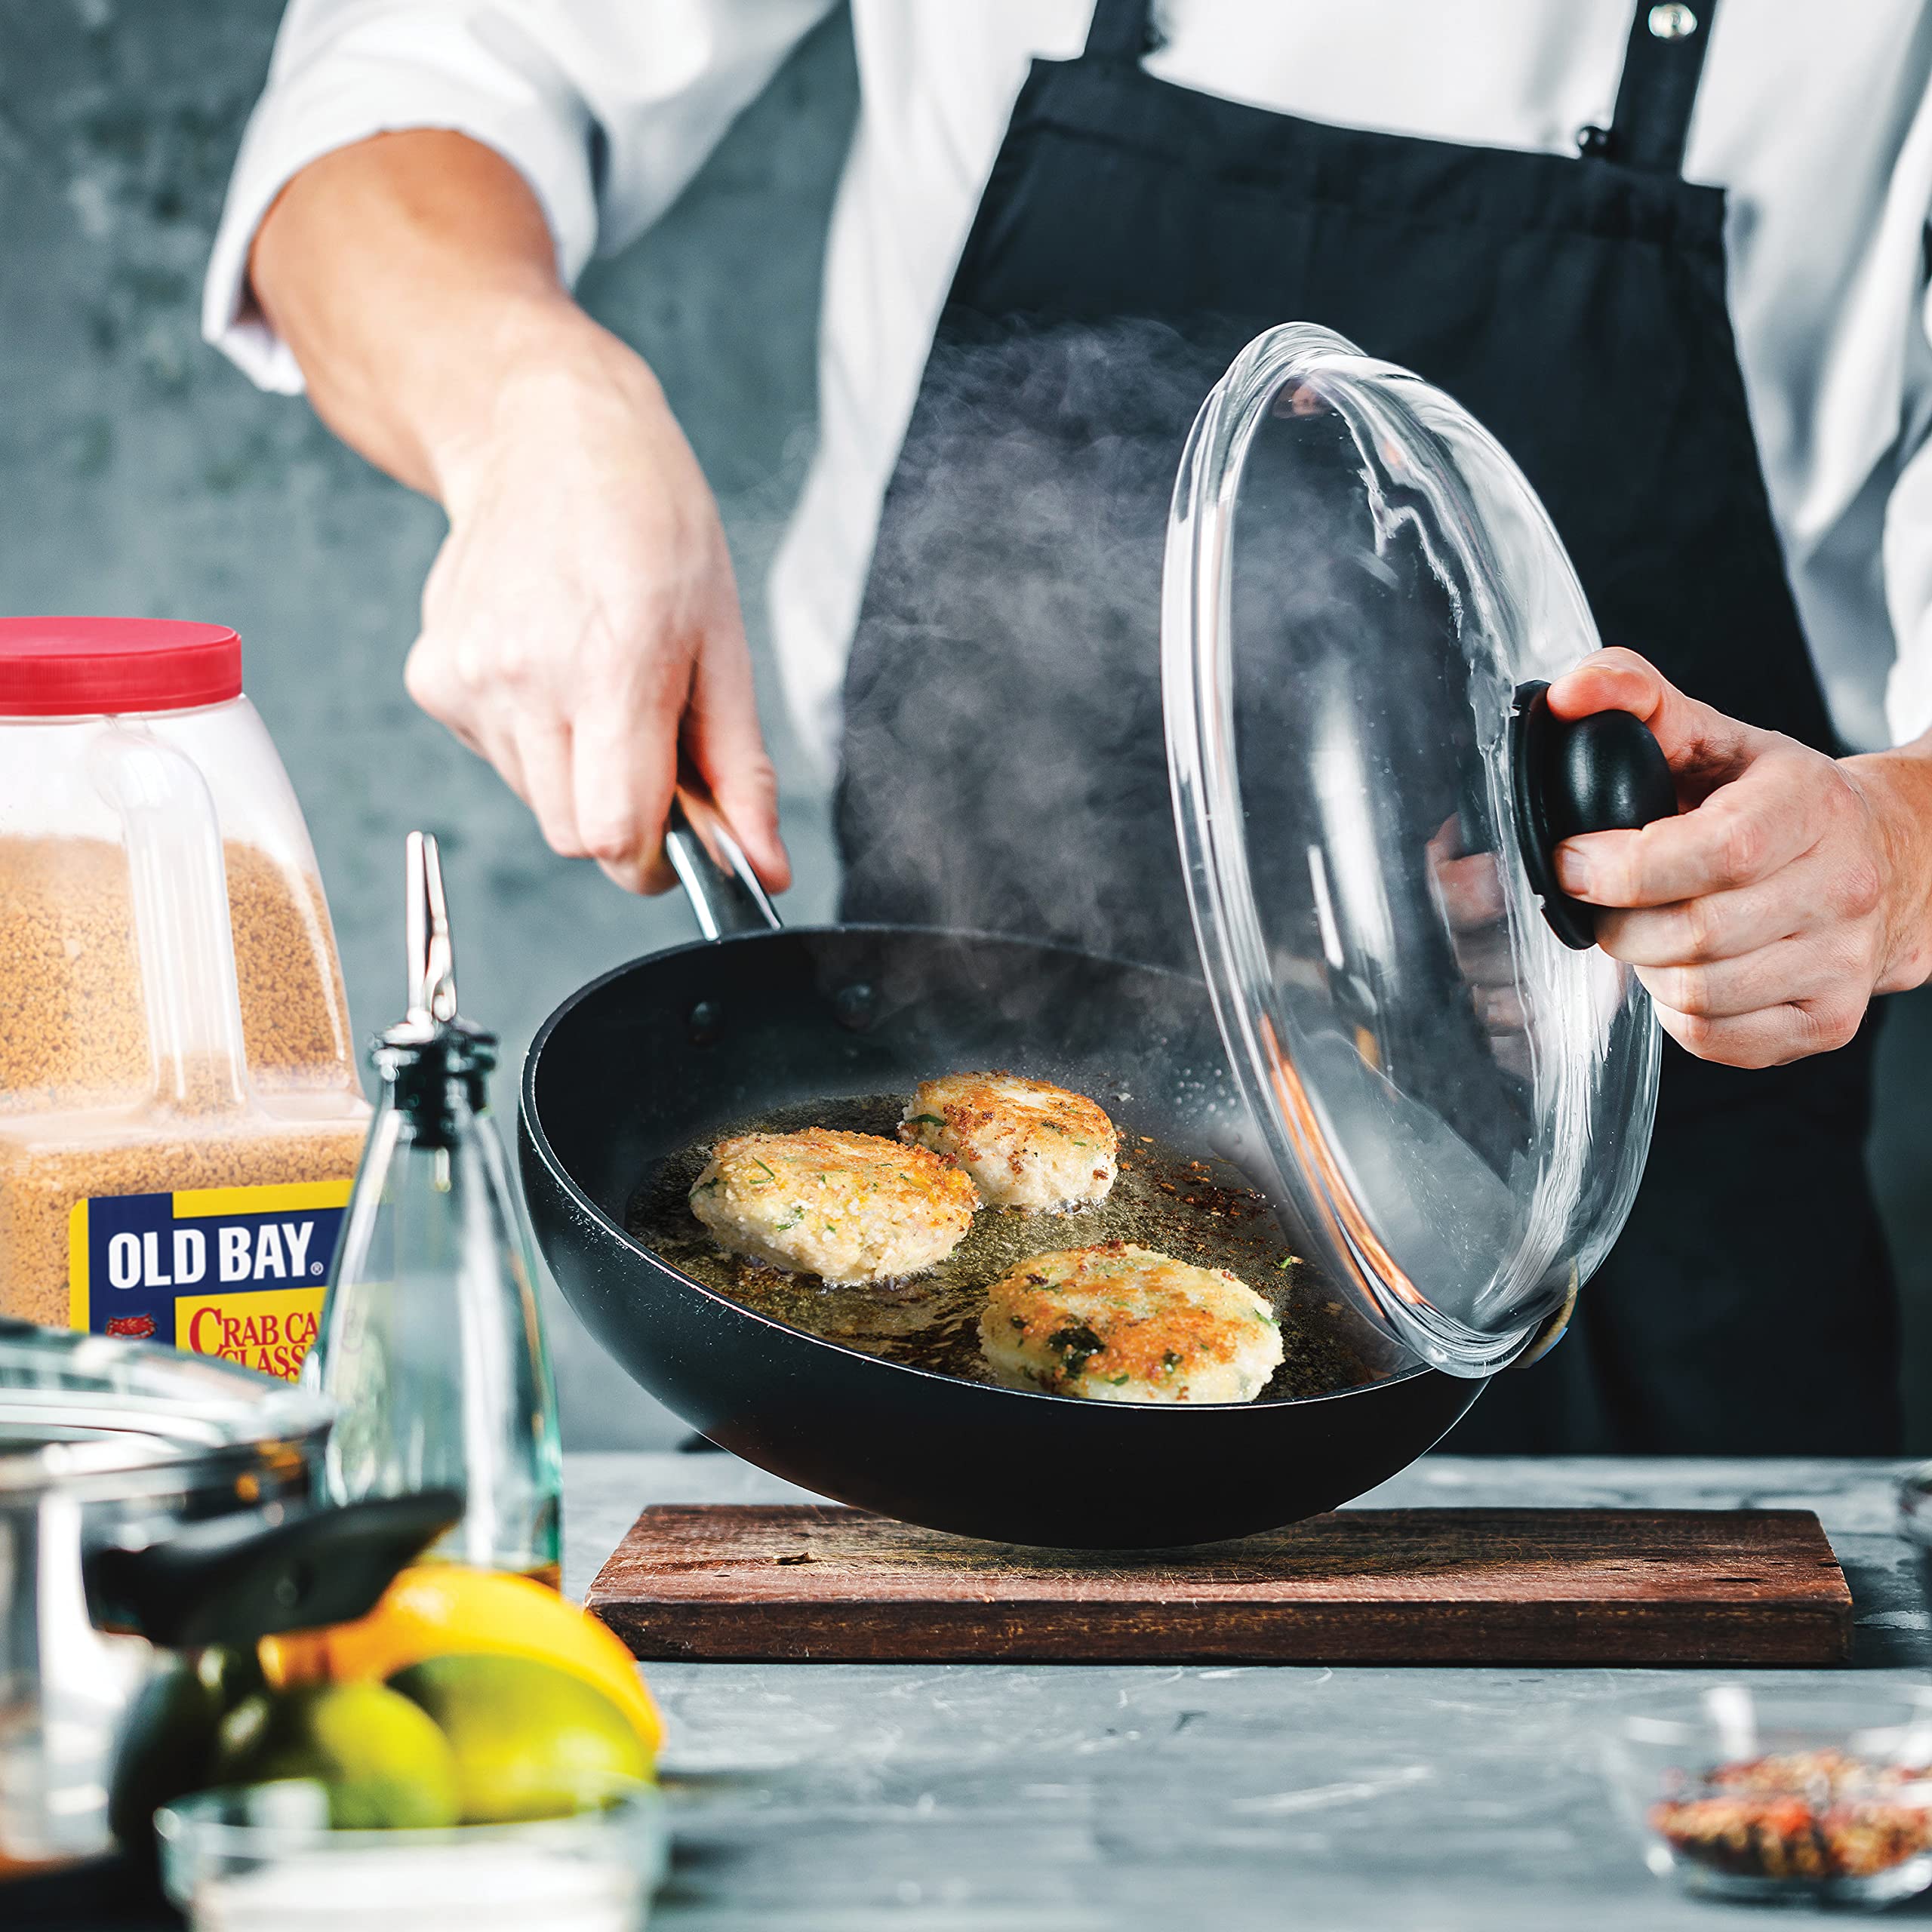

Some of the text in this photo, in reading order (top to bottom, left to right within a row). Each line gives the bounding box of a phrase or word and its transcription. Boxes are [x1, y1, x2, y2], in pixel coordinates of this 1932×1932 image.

[108, 1229, 207, 1289] OLD
[189, 1307, 323, 1357] CRAB CA
